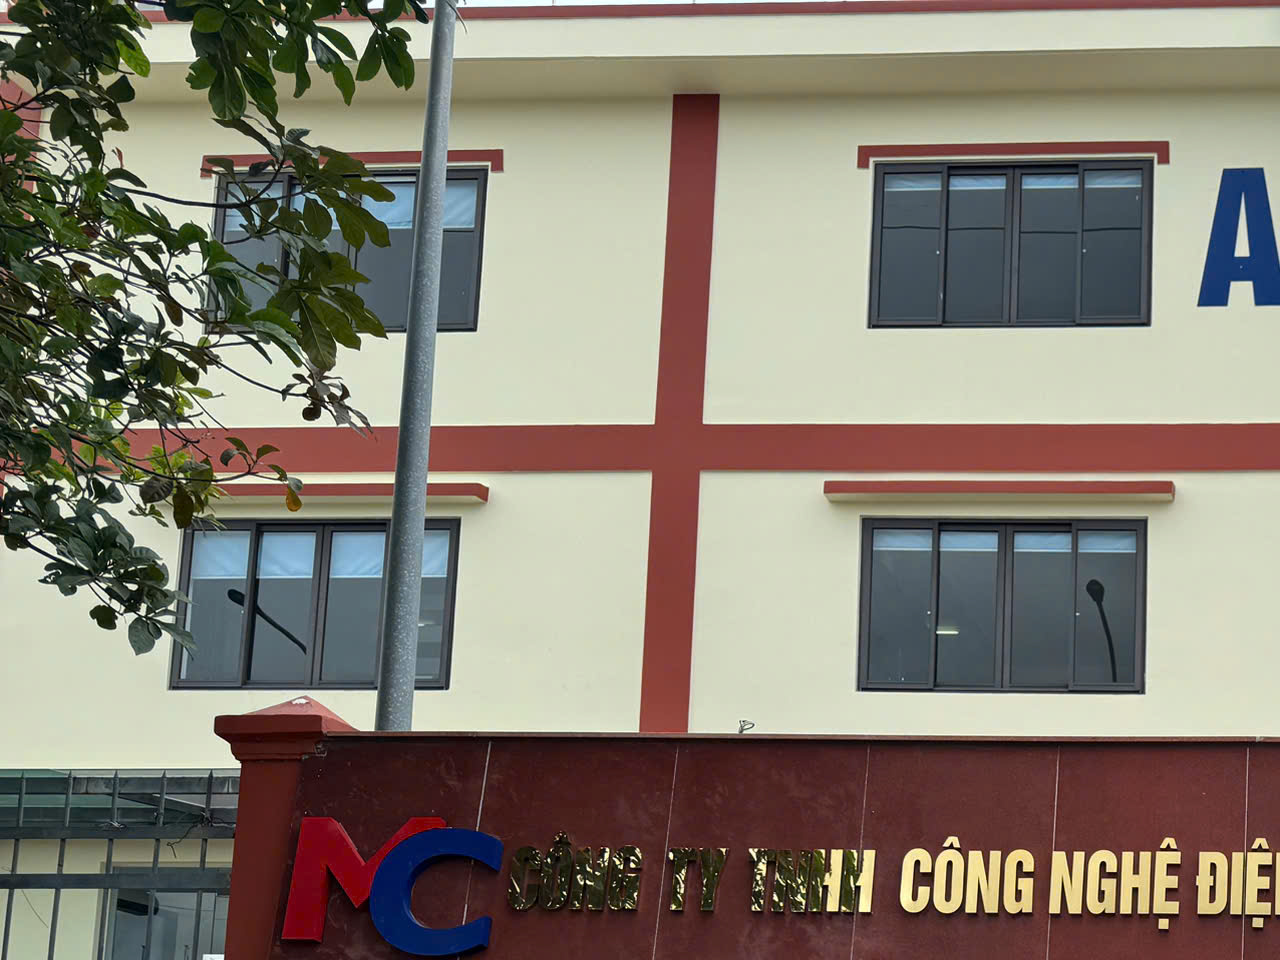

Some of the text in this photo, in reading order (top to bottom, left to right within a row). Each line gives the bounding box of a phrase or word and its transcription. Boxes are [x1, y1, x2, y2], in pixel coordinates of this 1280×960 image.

[282, 816, 503, 956] MC
[507, 831, 642, 912] CÔNG
[668, 847, 730, 912] TY
[748, 848, 876, 913] TNHH
[899, 836, 1035, 914] CÔNG
[1049, 837, 1182, 930] NGHỆ
